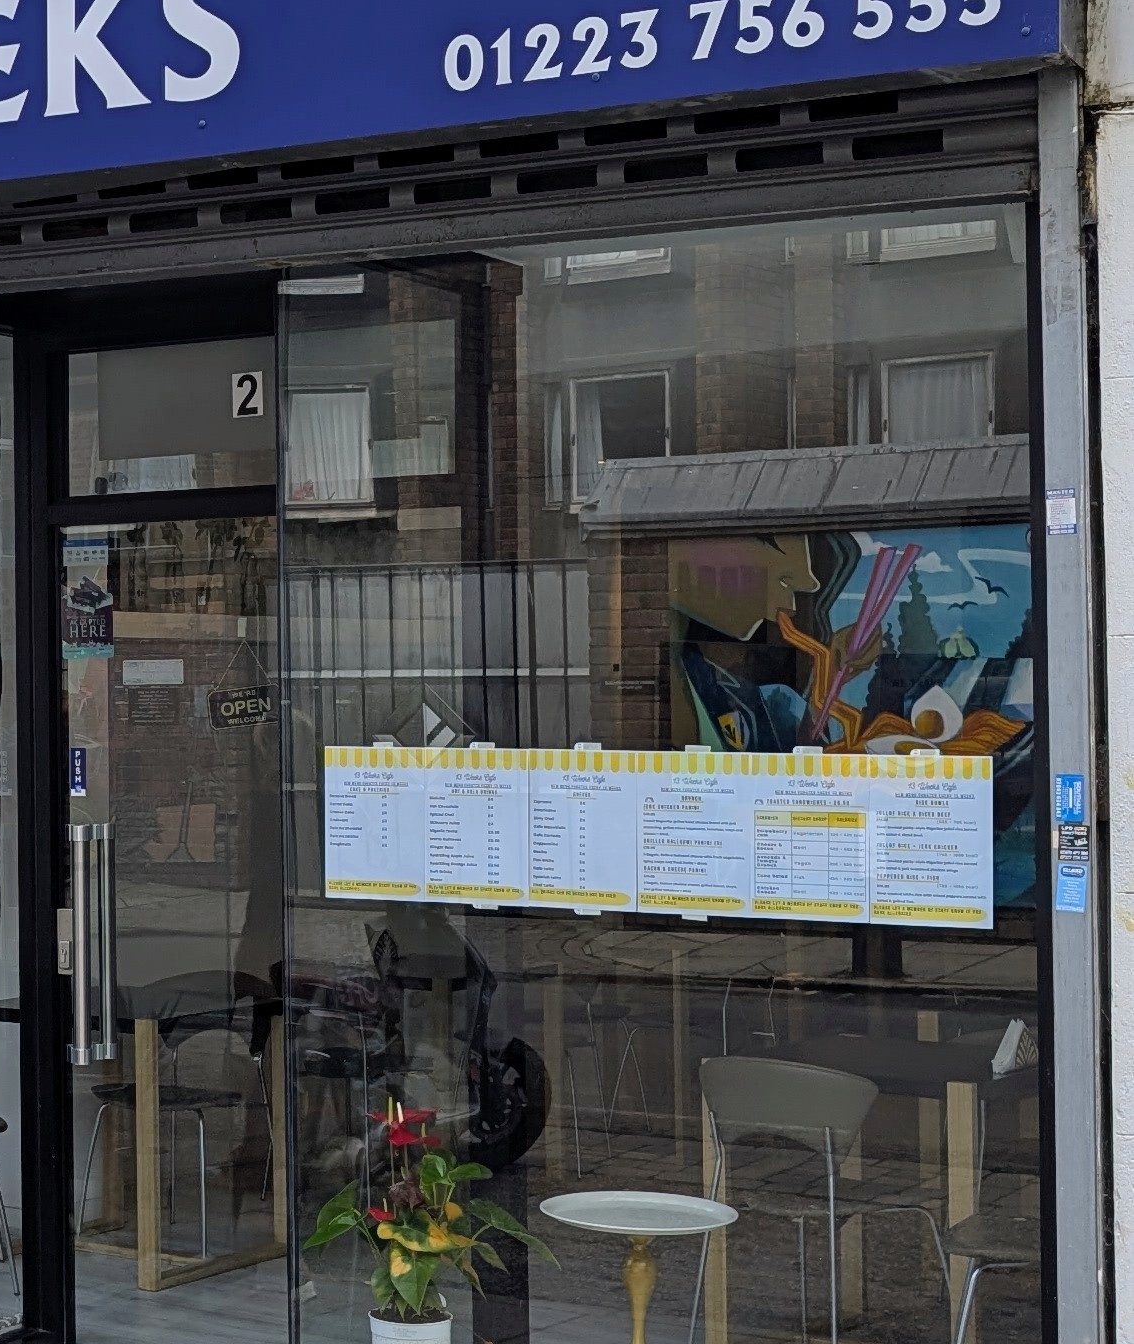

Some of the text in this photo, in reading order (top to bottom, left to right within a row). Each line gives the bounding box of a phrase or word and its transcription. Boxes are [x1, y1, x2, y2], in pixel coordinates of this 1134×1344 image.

[444, 9, 659, 92] 01223
[236, 374, 259, 417] 2
[69, 625, 107, 639] HERE
[220, 697, 272, 716] OPEN
[74, 749, 83, 784] PUSH
